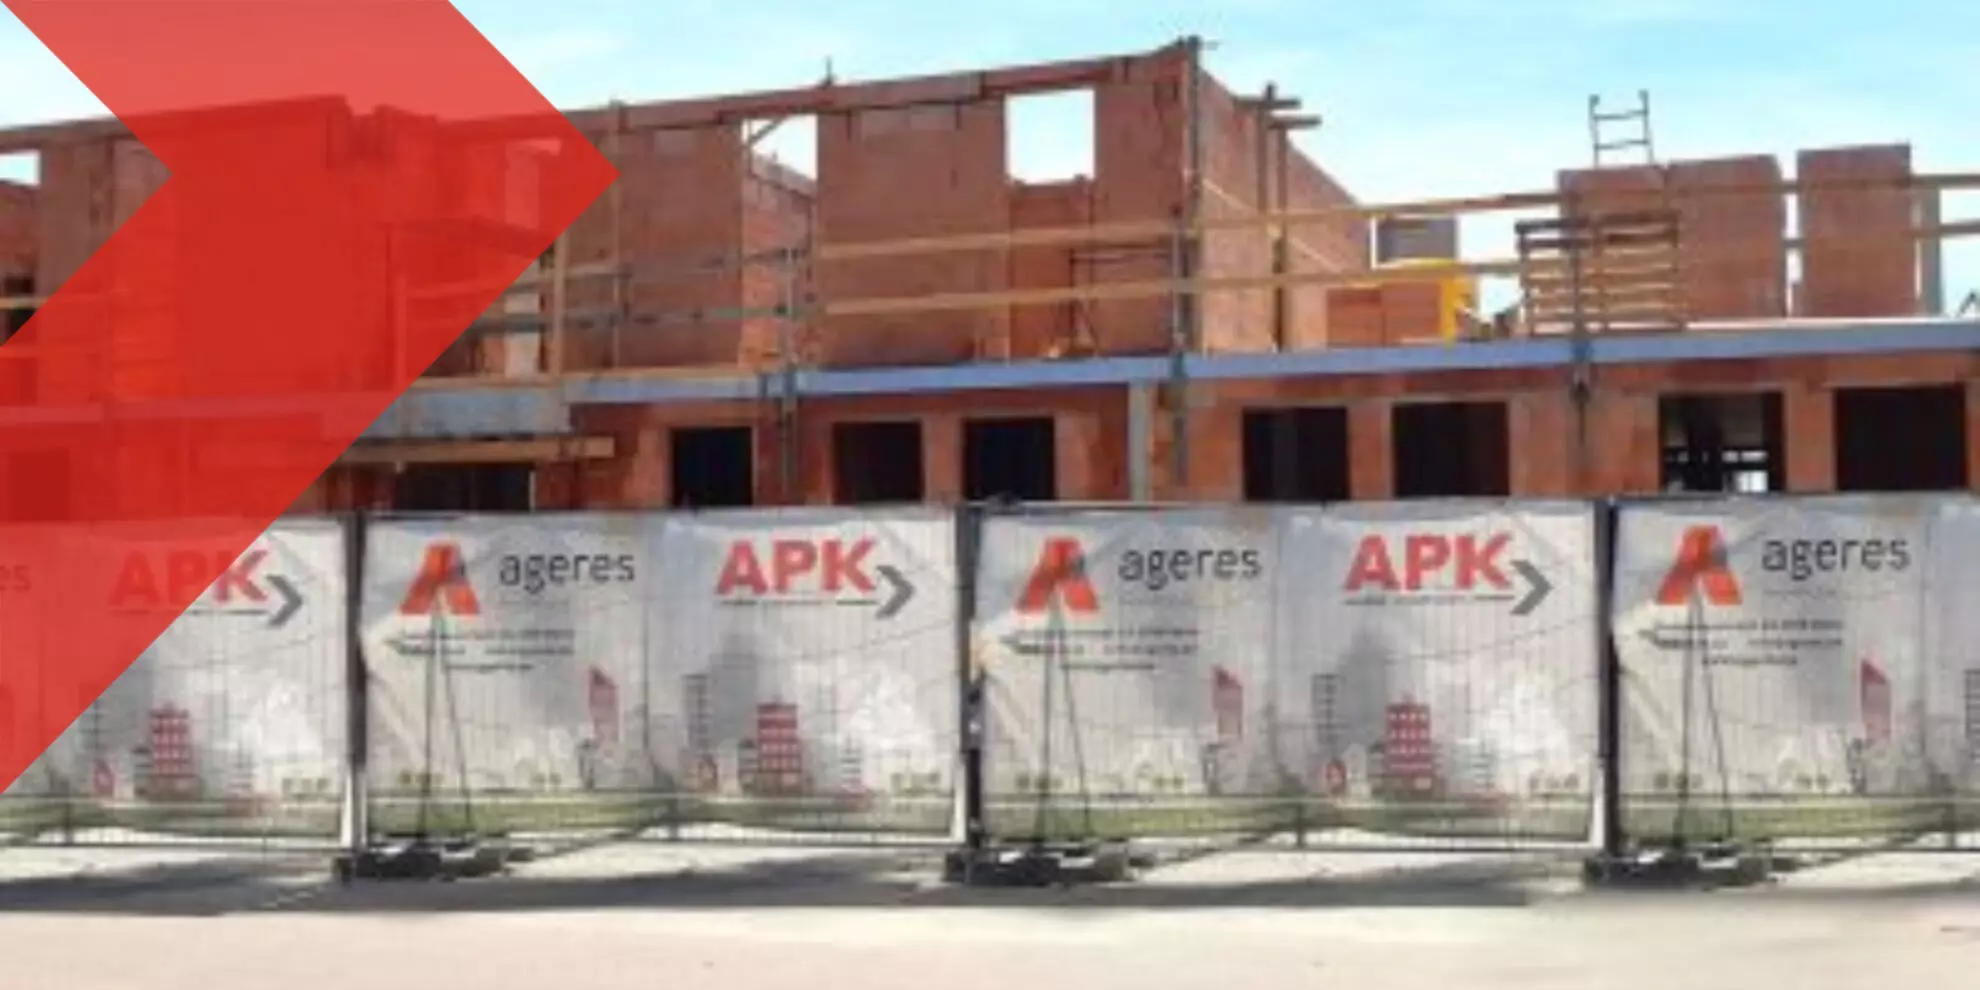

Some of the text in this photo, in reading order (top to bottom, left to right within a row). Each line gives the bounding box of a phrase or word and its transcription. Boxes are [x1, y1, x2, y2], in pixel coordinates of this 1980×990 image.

[107, 548, 269, 606] APK
[499, 553, 635, 595] ageres
[715, 537, 876, 595] APK
[1117, 548, 1263, 591] ageres
[1343, 533, 1513, 593] APK
[1761, 538, 1911, 581] ageres
